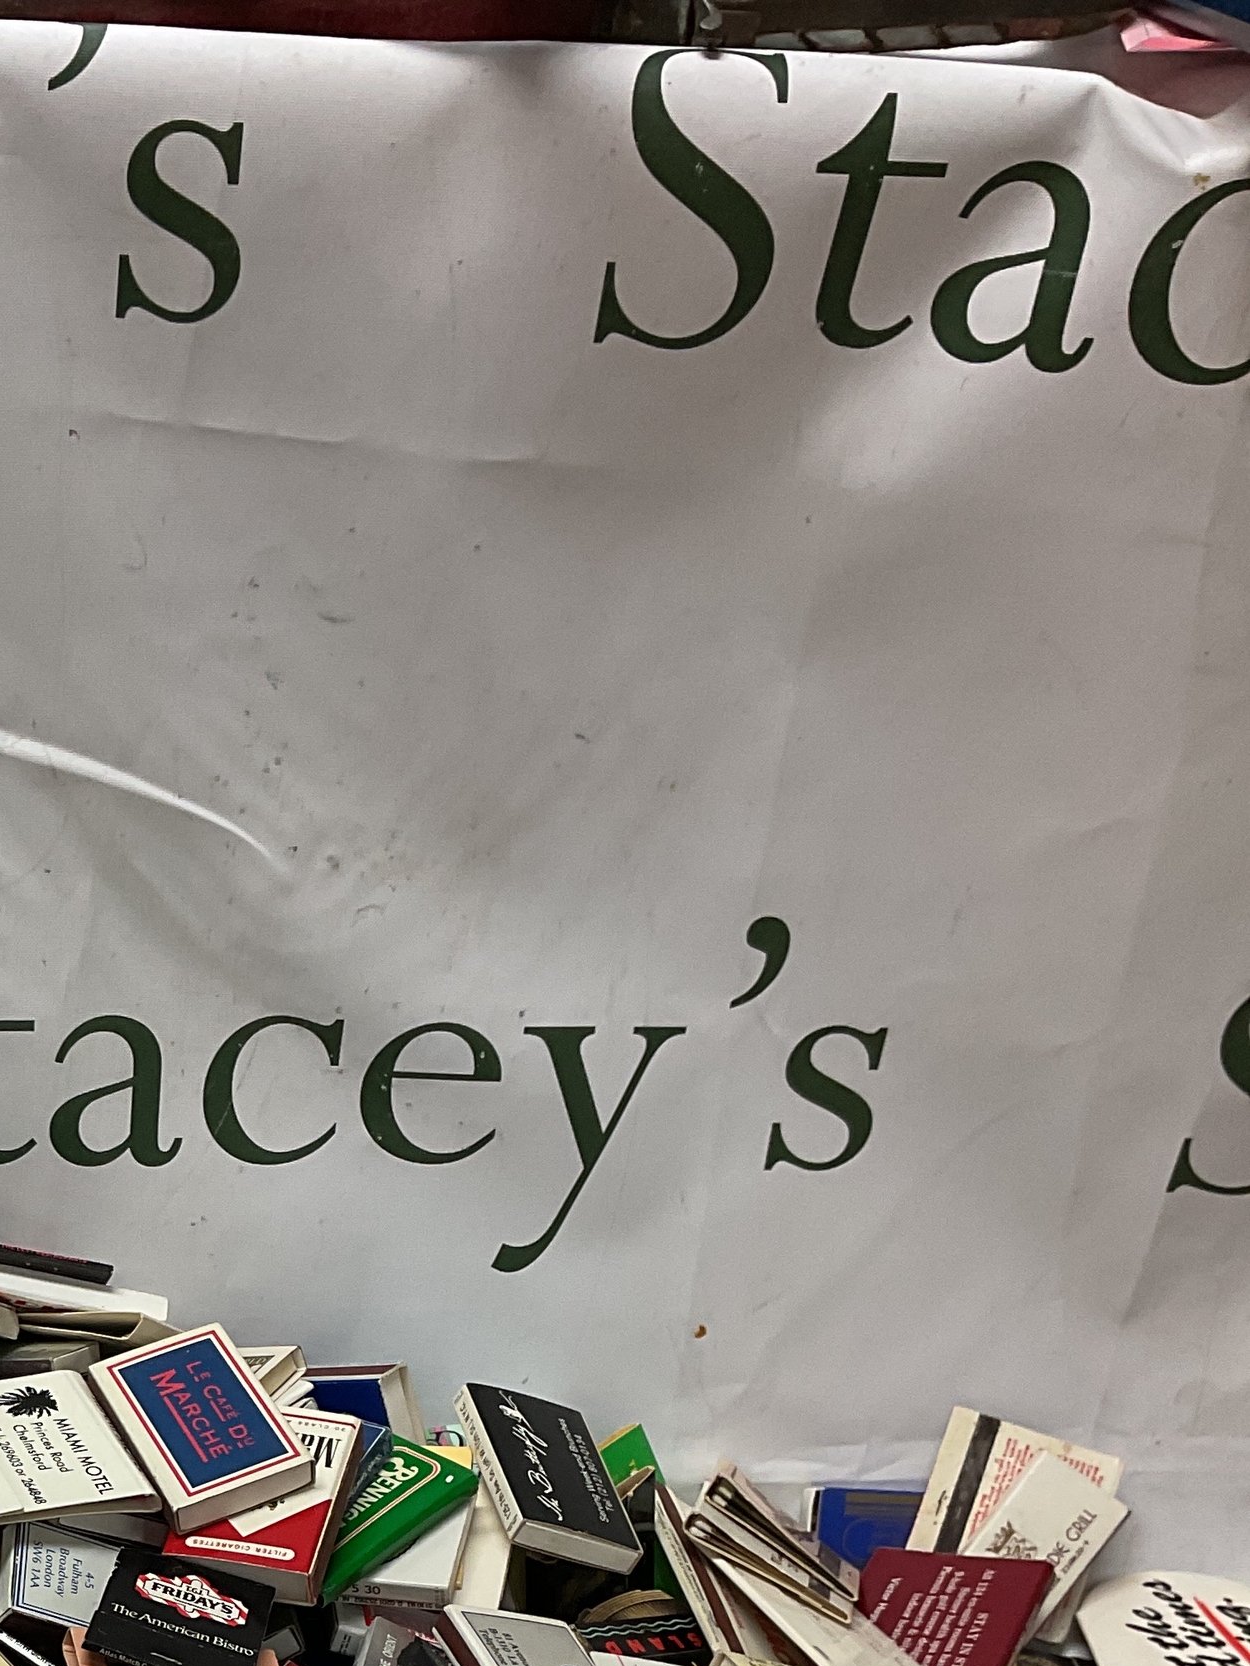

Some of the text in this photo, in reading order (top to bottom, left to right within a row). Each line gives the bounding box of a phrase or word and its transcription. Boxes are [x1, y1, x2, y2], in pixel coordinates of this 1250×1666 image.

[0, 1441, 20, 1467] 269603
[13, 1424, 50, 1471] Chelmsford
[31, 1422, 74, 1473] Princes Road
[53, 1418, 114, 1495] MIAMI MOTEL
[32, 1540, 43, 1564] SW6
[192, 1539, 288, 1558] FILTER CIGARETTES
[43, 1548, 55, 1588] London
[58, 1548, 70, 1598] Broadway
[71, 1558, 82, 1594] Fulham
[84, 1572, 94, 1589] 4-5
[151, 1582, 234, 1615] FRIDAY'S
[1143, 1579, 1226, 1650] times
[112, 1603, 255, 1656] The American Bistro
[382, 1634, 398, 1659] ORIENT
[1126, 1607, 1190, 1651] the
[100, 1649, 118, 1660] Atlas
